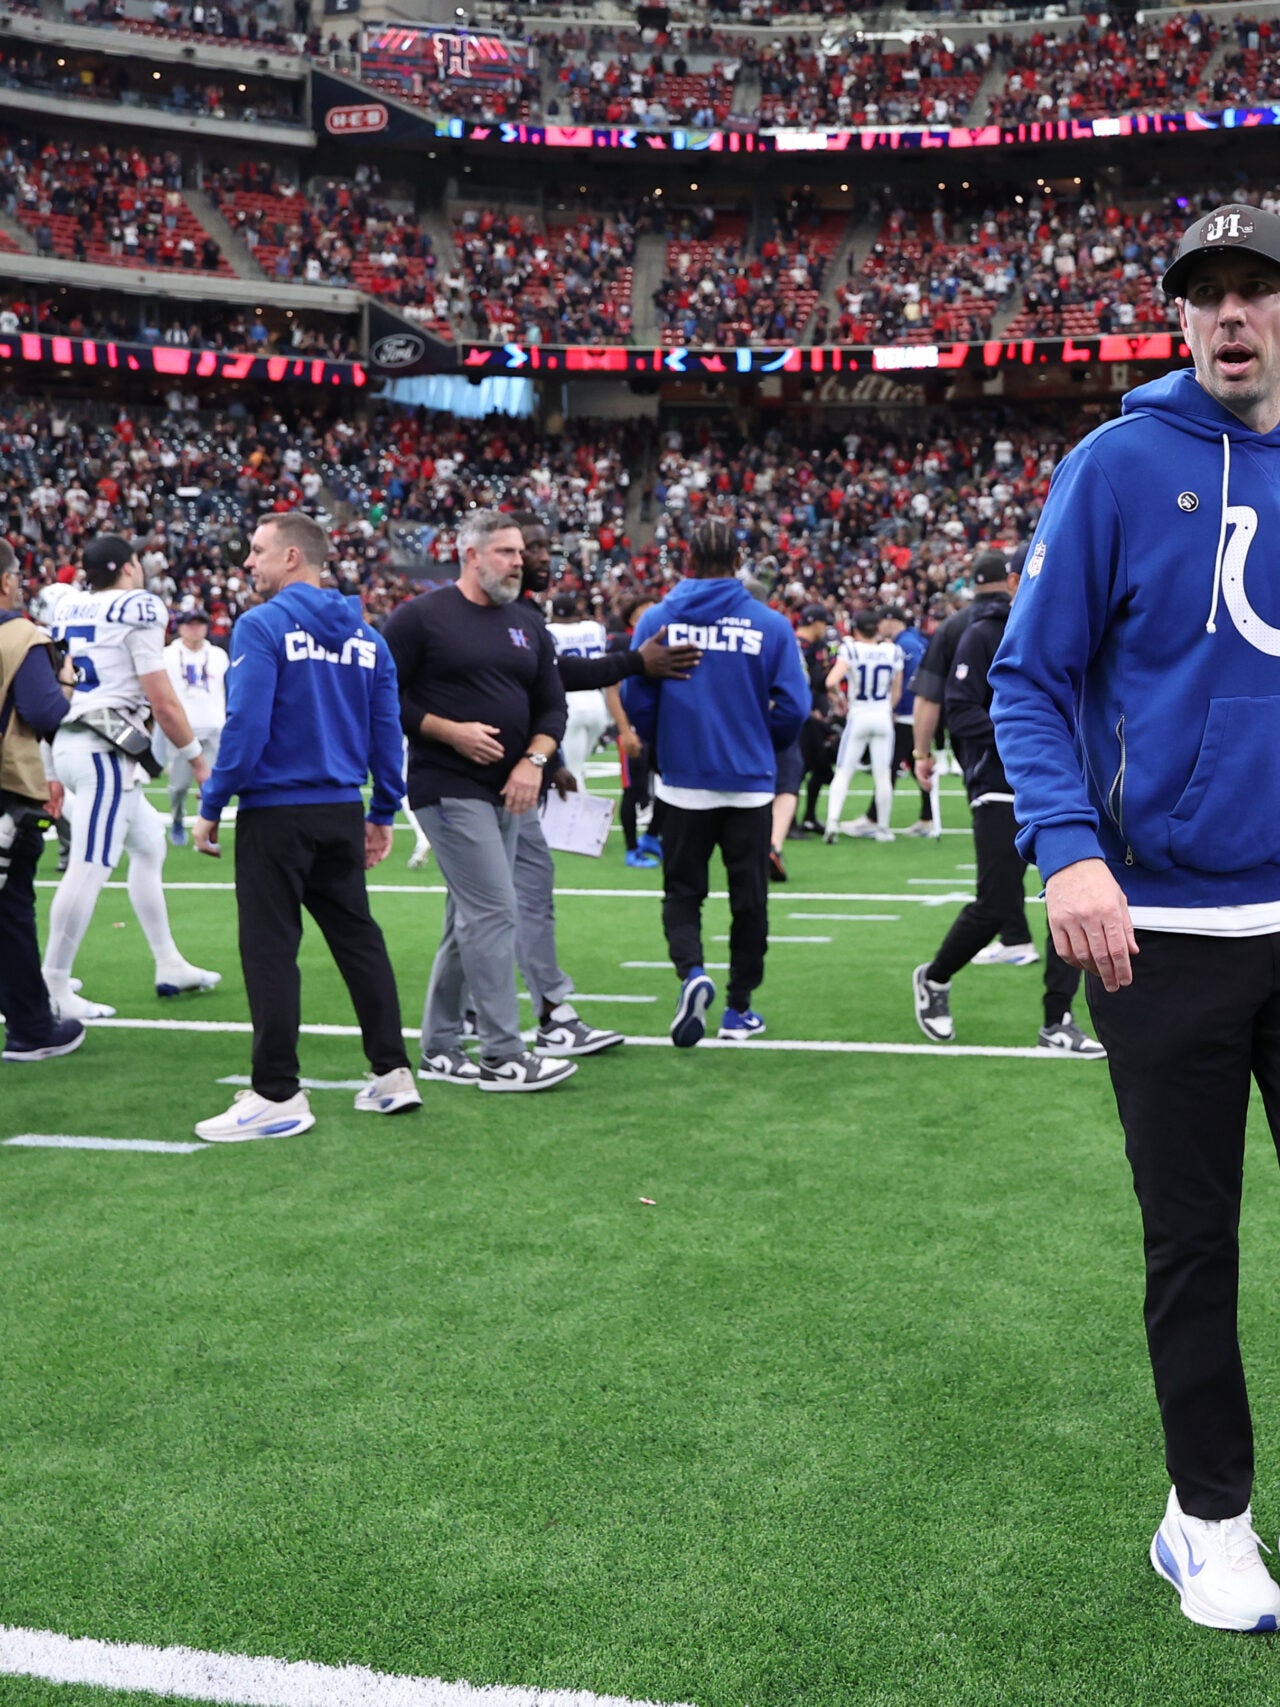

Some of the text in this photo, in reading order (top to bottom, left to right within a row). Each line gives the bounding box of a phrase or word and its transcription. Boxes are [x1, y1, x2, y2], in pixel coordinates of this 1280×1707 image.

[379, 338, 416, 363] Ford
[136, 602, 158, 623] 15
[667, 622, 764, 656] COLTS
[855, 663, 893, 702] 10
